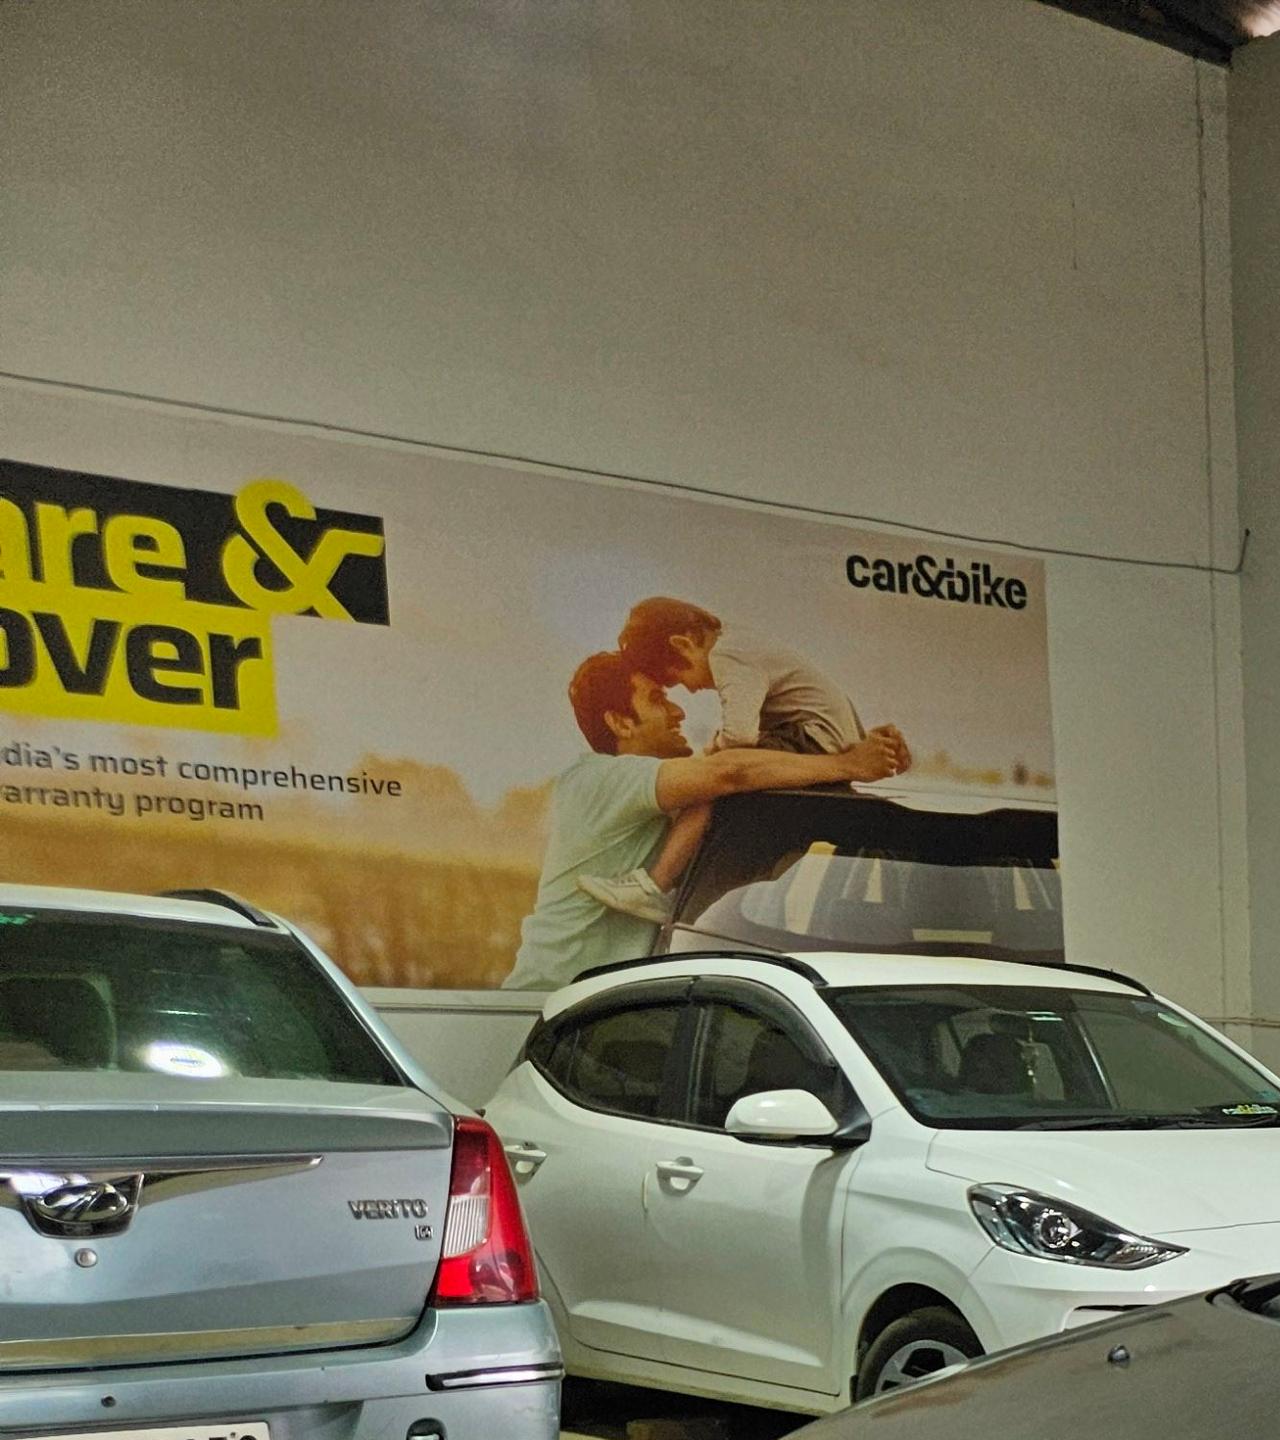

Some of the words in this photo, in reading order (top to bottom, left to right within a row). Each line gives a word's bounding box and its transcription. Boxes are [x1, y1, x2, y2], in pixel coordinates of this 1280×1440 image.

[846, 554, 1027, 610] car&bike
[88, 753, 168, 777] most
[178, 761, 402, 797] comprehensive
[0, 783, 126, 816] arranty
[135, 793, 264, 821] program
